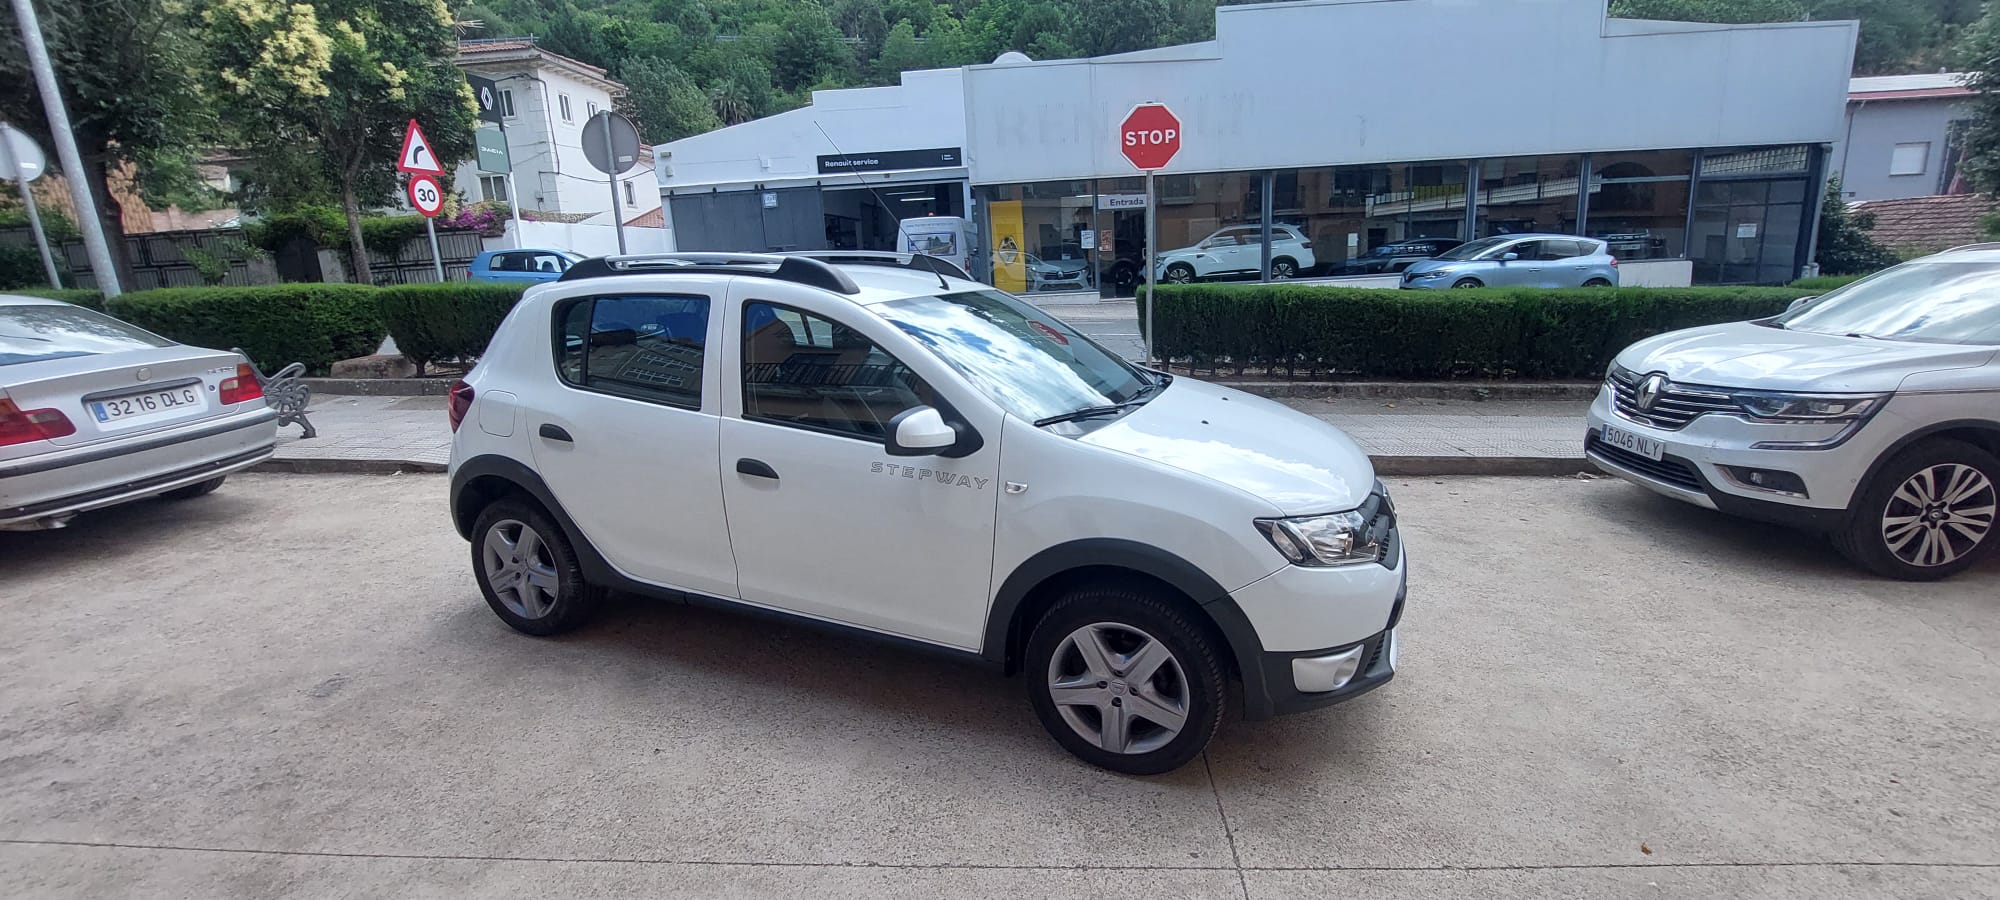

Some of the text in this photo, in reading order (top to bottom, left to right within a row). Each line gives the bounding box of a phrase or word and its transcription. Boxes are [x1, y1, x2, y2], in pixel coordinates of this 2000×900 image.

[1125, 129, 1176, 146] STOP
[825, 159, 852, 167] Renault
[418, 188, 436, 202] 30
[1110, 197, 1144, 206] Entrada
[107, 390, 195, 416] 3216 DLG
[1608, 429, 1660, 457] 5046 NLY
[870, 461, 988, 489] STEPWAY
